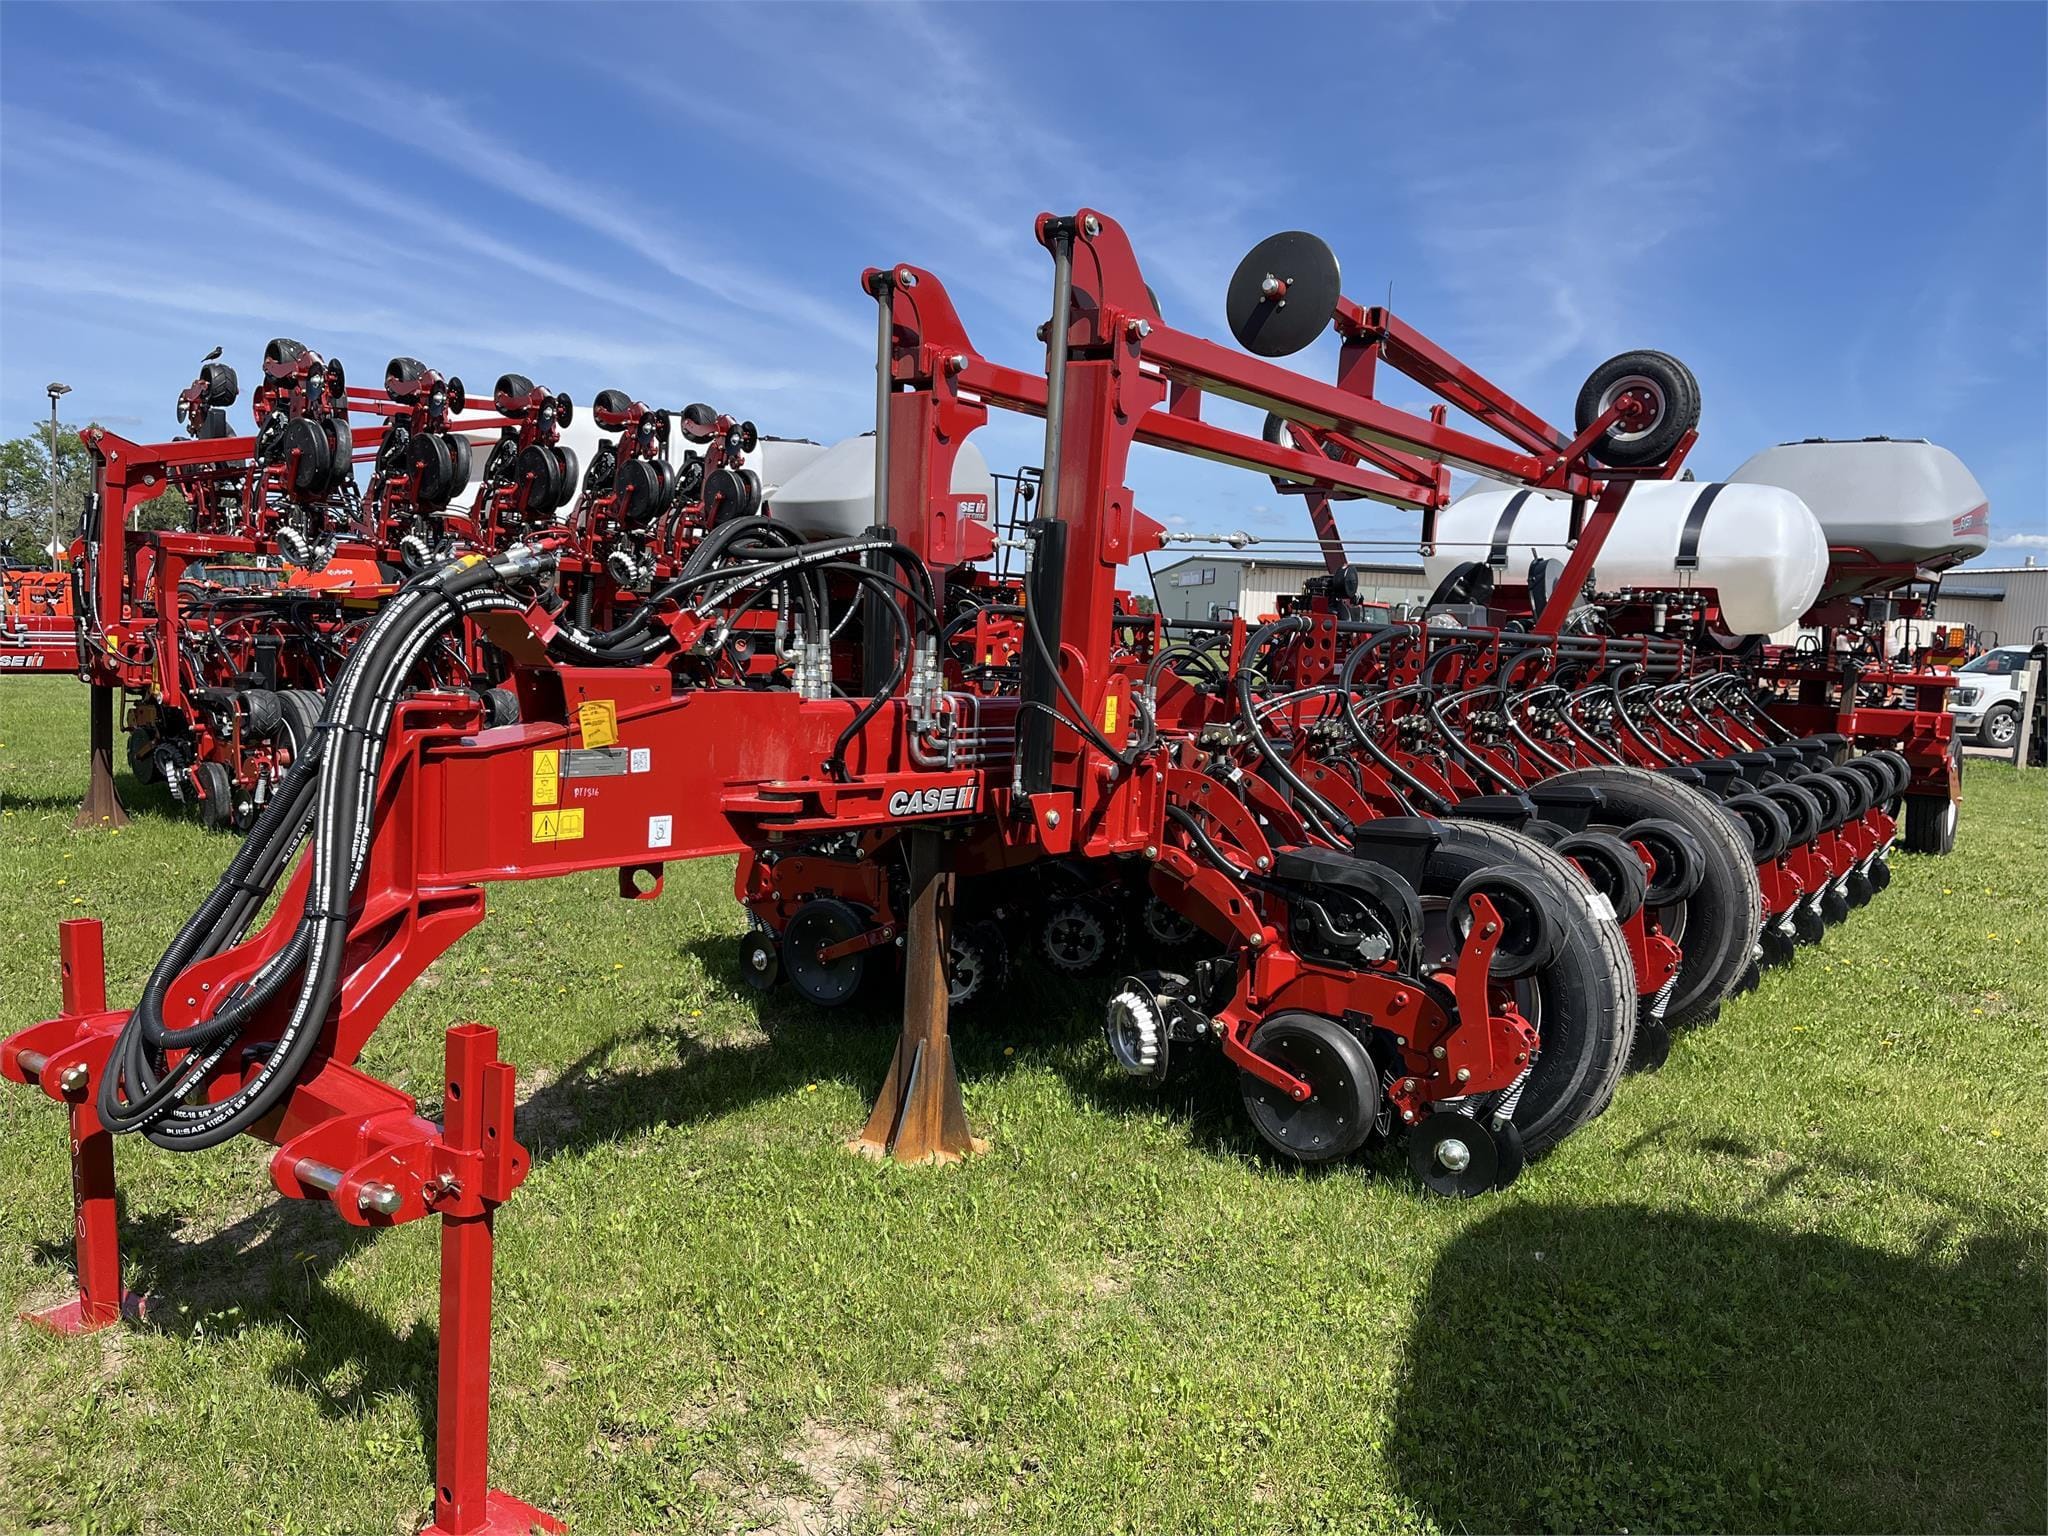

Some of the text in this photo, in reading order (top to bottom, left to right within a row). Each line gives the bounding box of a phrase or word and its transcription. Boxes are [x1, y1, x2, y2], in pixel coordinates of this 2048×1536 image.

[889, 788, 957, 816] CASE
[166, 1124, 206, 1135] PULSAR
[206, 1108, 236, 1128] 112CC-10
[234, 1096, 247, 1110] 5/8"
[247, 1080, 264, 1097] 3600
[260, 1070, 272, 1082] PSI
[270, 1054, 283, 1068] 250
[277, 1040, 290, 1055] BAR
[285, 1028, 296, 1041] WP
[291, 999, 309, 1027] EXCEEDS
